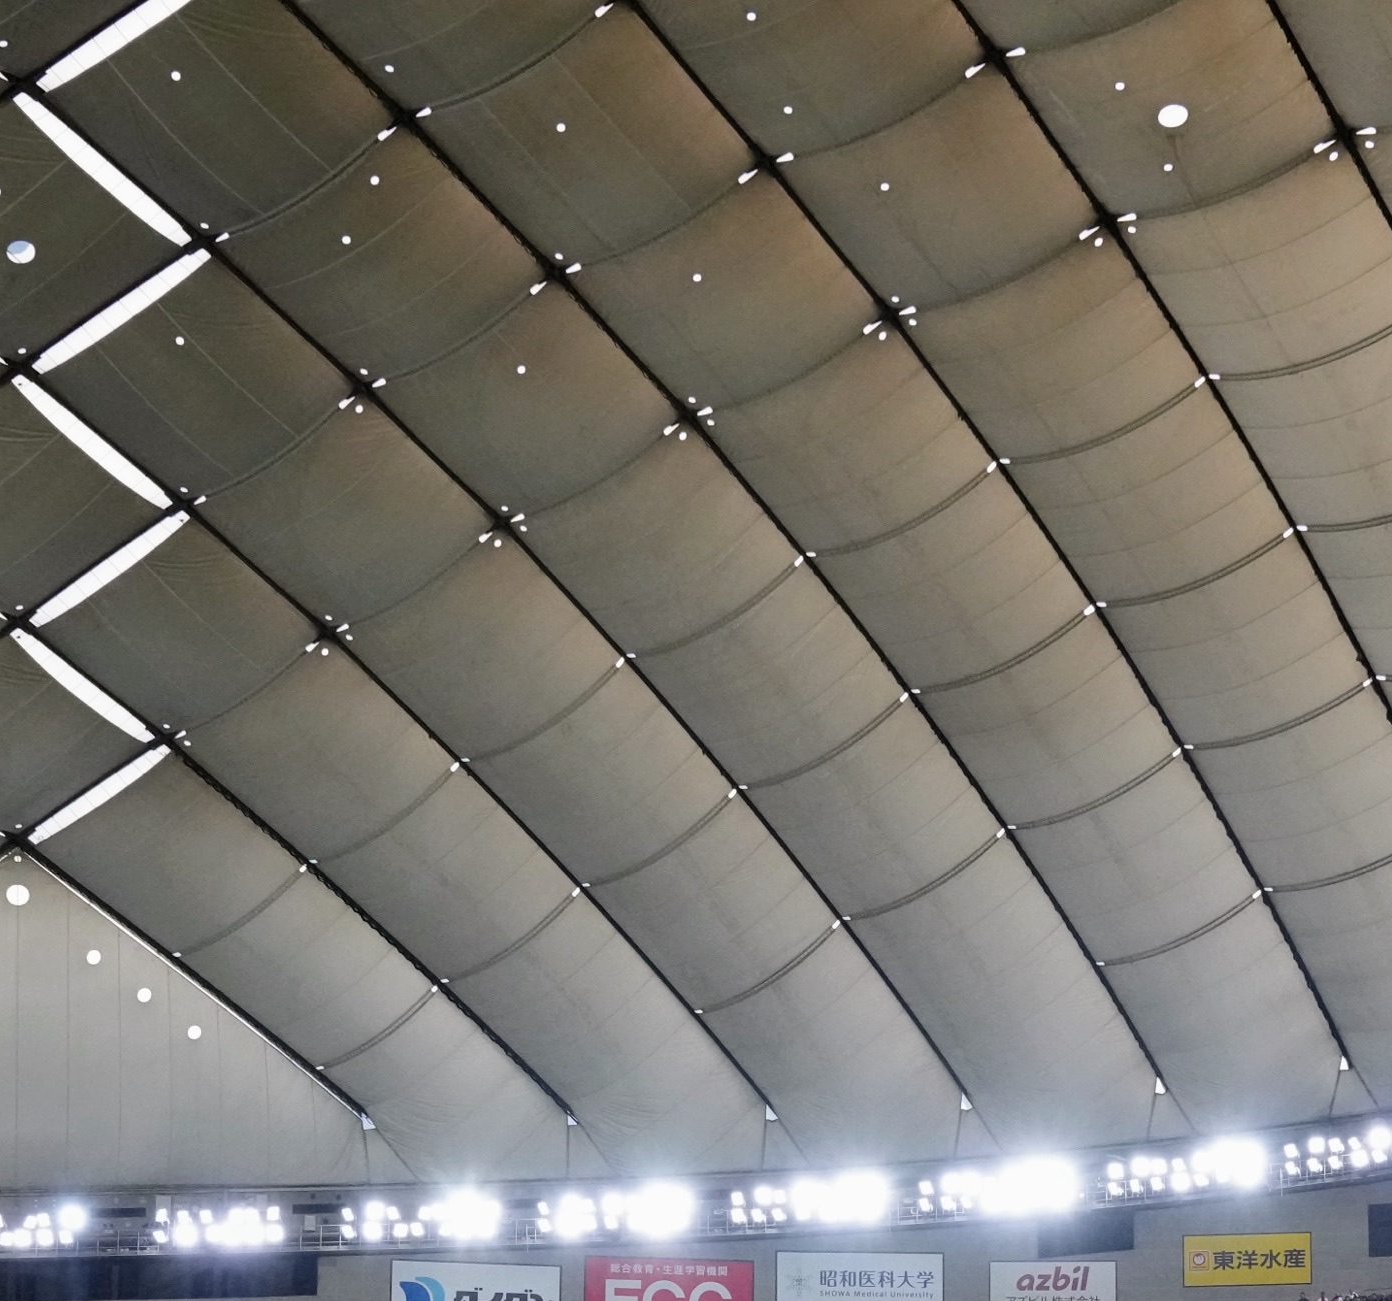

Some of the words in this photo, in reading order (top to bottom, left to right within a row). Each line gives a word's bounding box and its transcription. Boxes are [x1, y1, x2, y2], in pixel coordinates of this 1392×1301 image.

[610, 1263, 729, 1277] 総合教育・生涯学習機関
[1212, 1249, 1306, 1271] 東洋水産
[819, 1269, 935, 1289] 昭和医科大学
[1016, 1265, 1090, 1292] azbil
[890, 1291, 935, 1299] University
